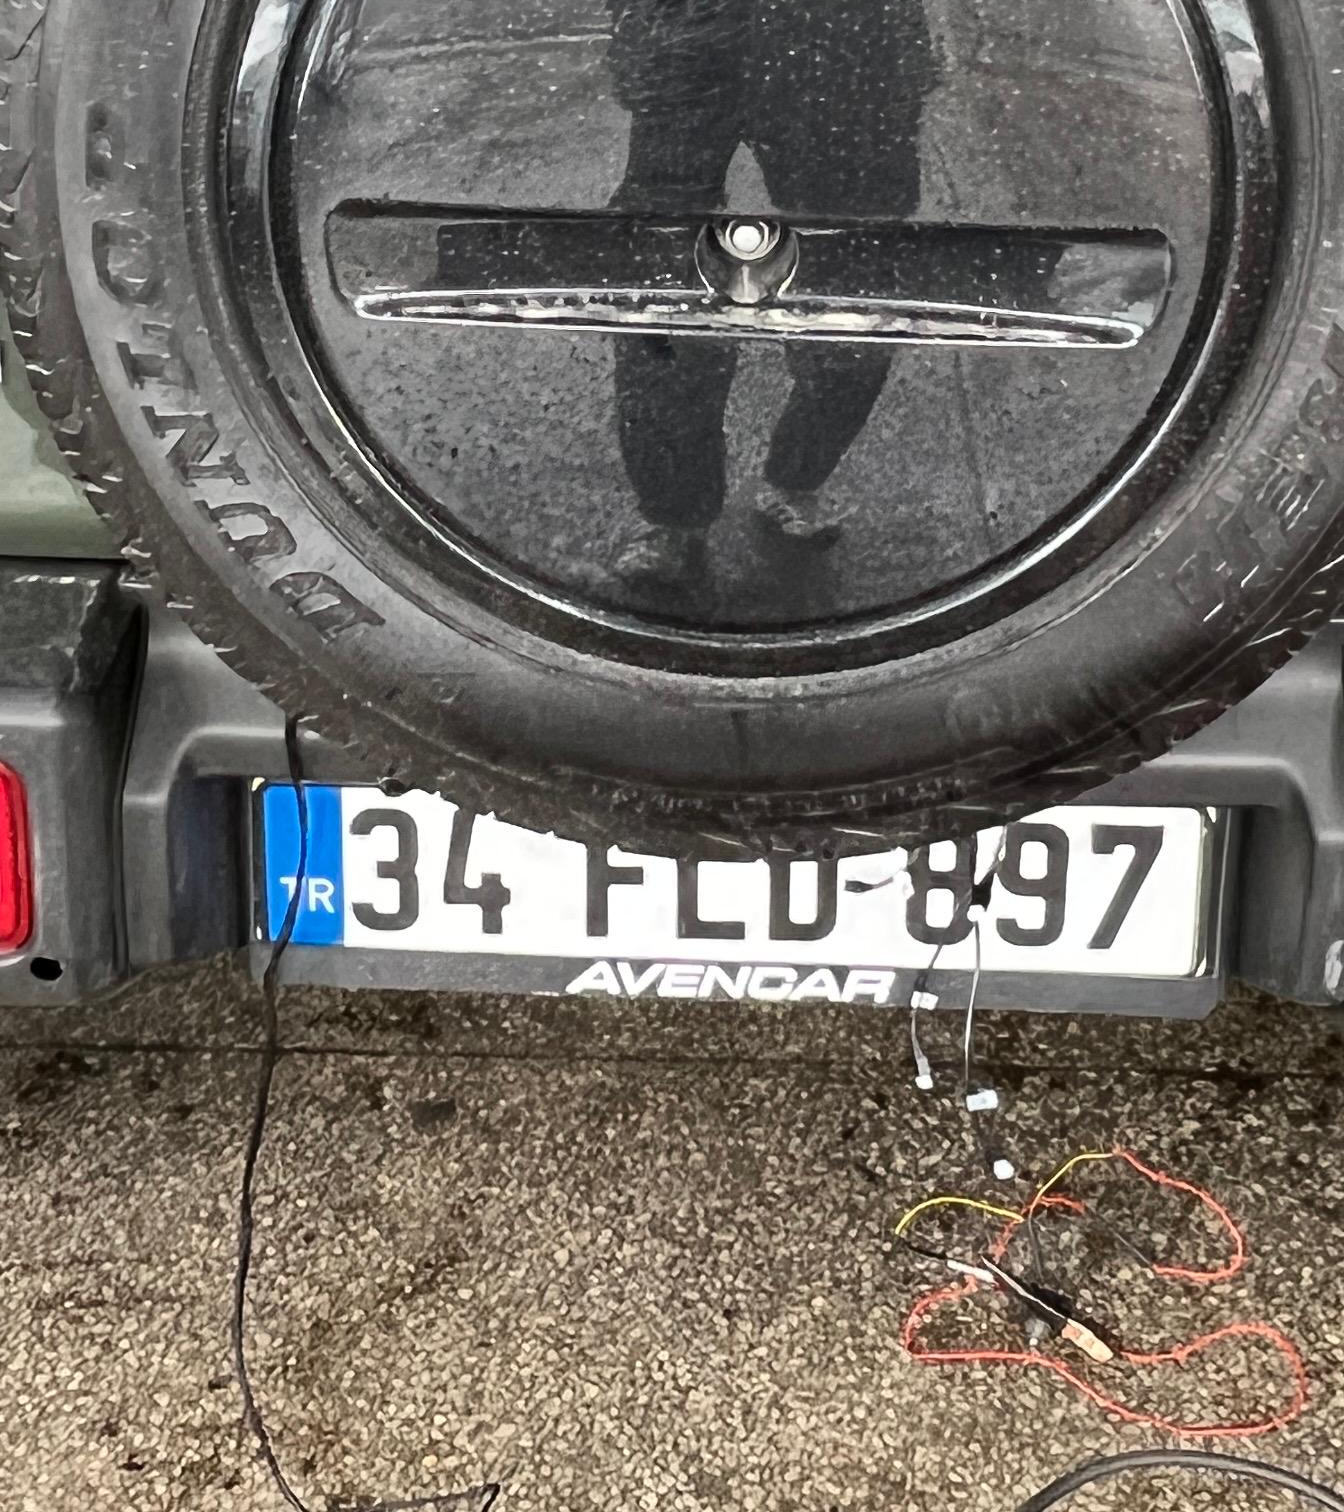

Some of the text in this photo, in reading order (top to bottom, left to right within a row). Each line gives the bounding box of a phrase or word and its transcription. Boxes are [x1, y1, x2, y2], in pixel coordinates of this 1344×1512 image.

[84, 100, 387, 644] DUNLOP
[349, 806, 512, 936] 34
[906, 821, 1166, 947] 897
[565, 960, 896, 1004] AVENCAR
